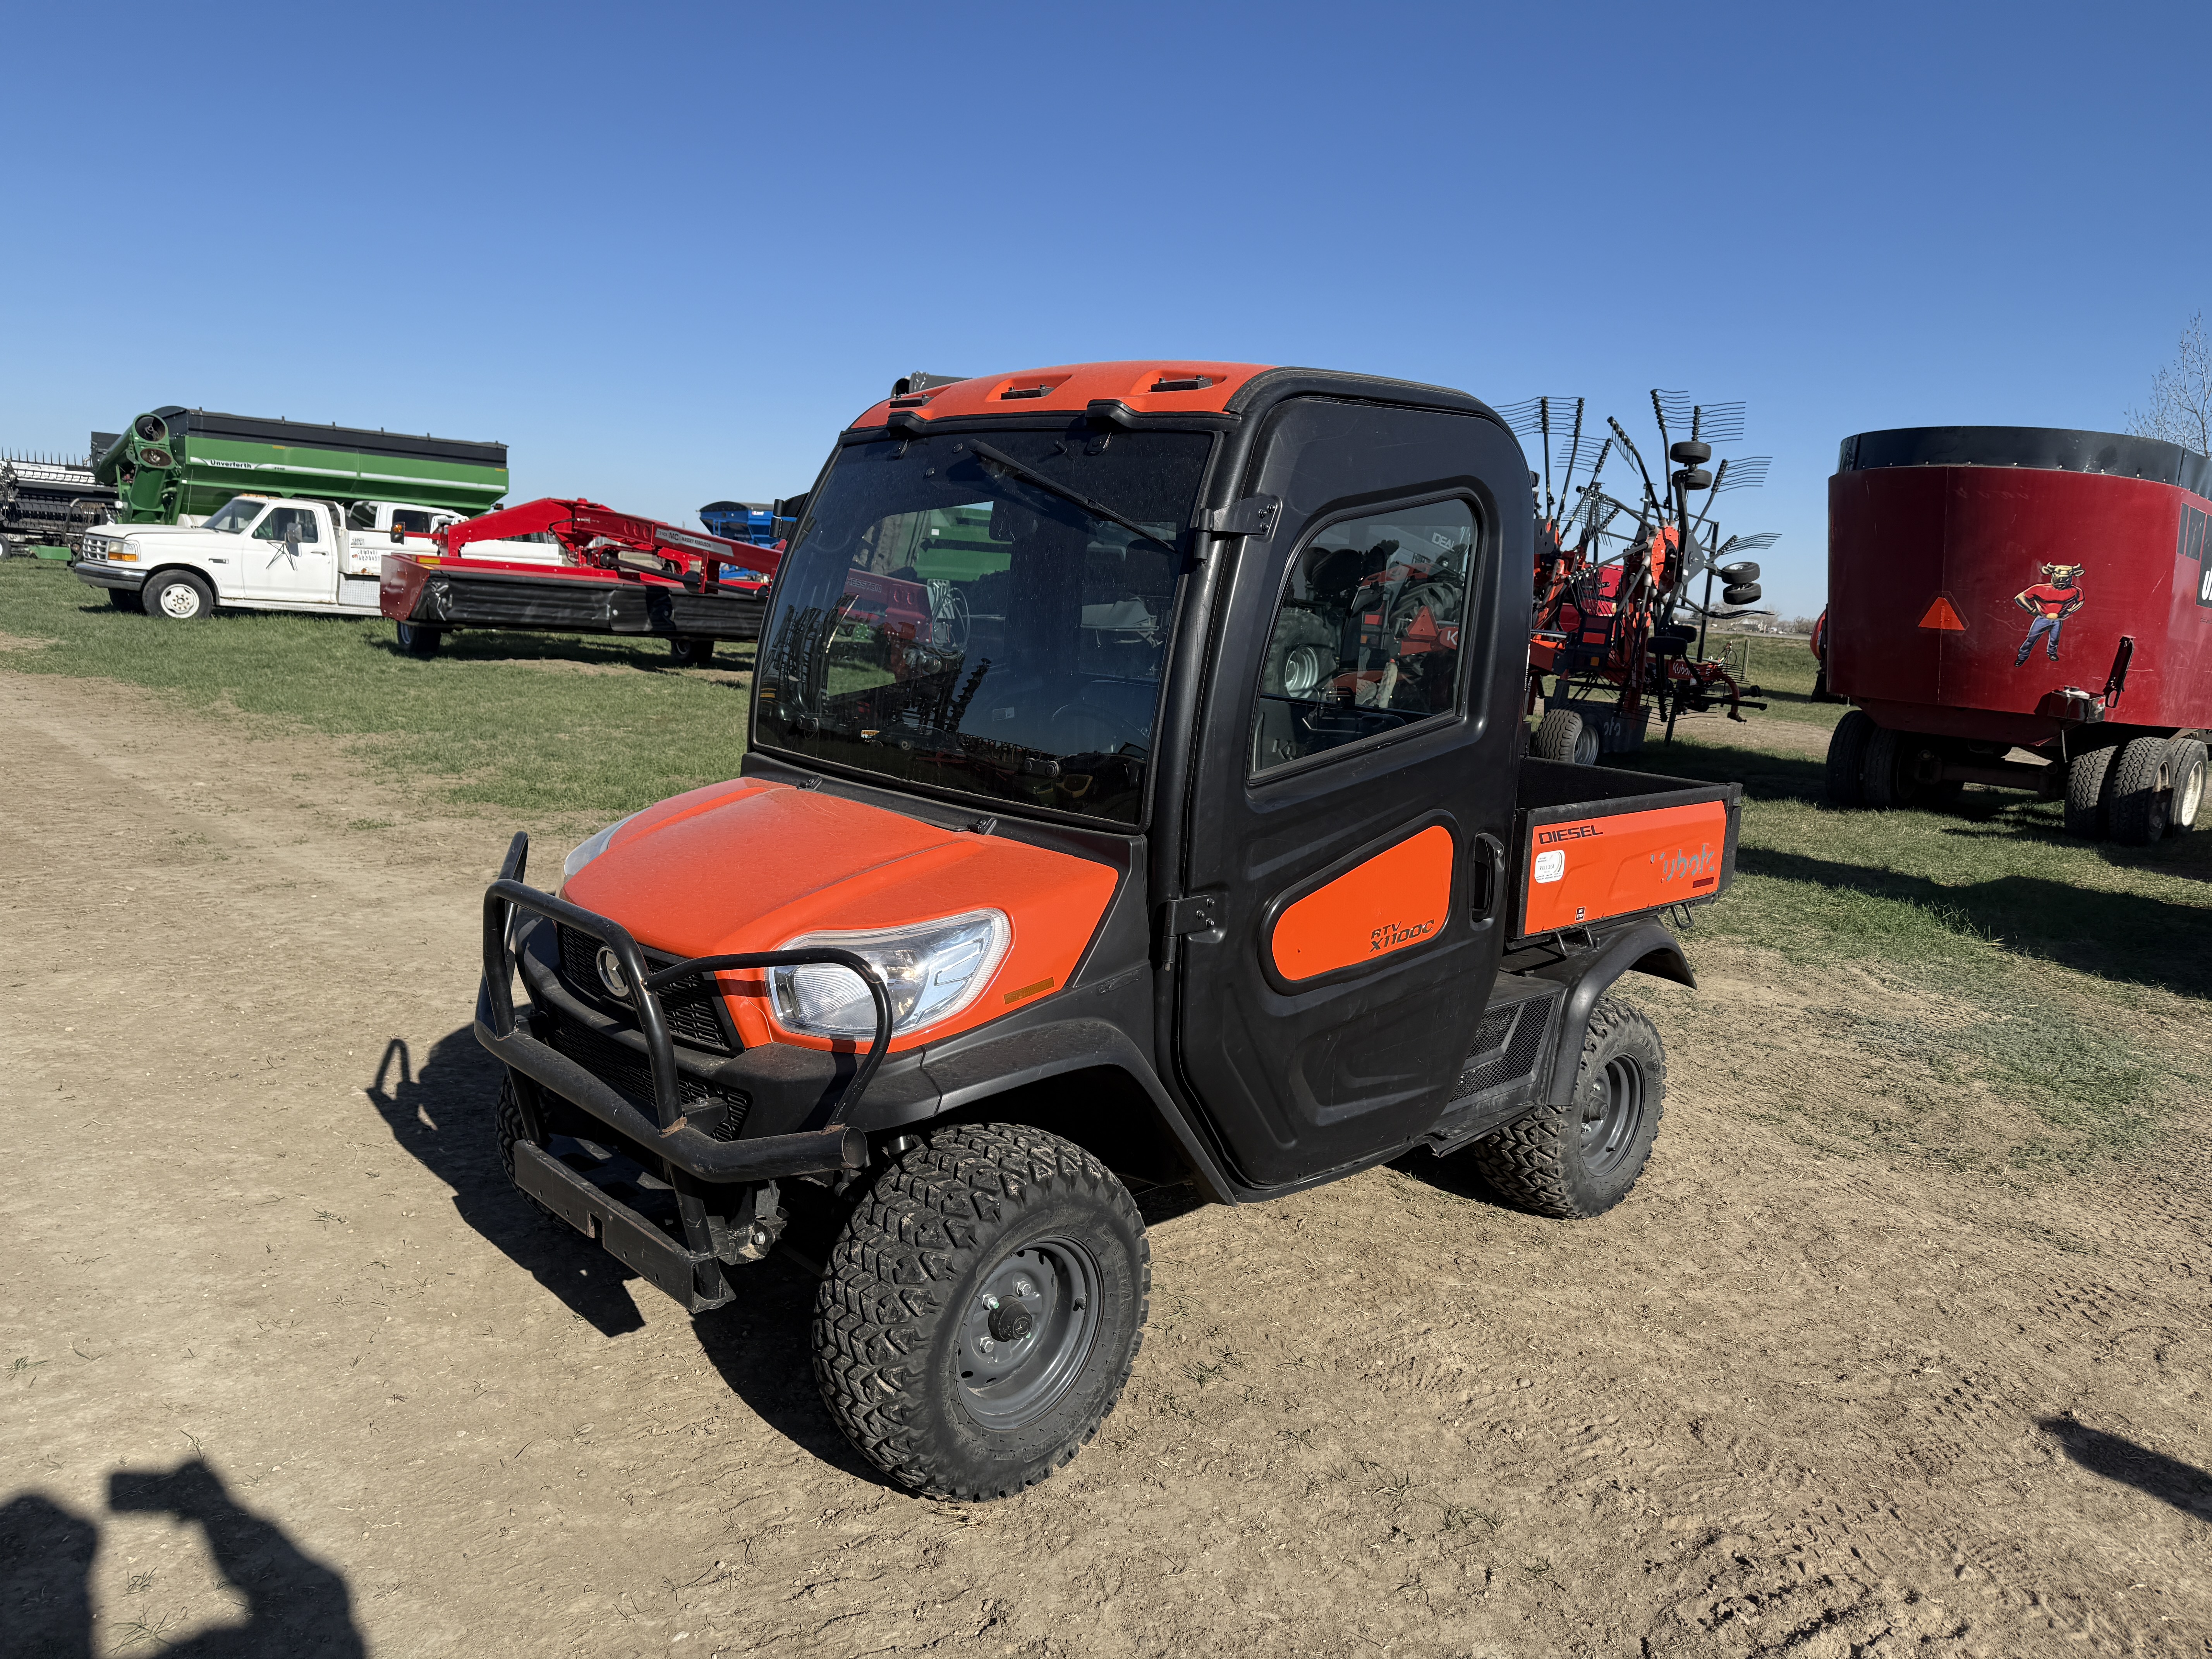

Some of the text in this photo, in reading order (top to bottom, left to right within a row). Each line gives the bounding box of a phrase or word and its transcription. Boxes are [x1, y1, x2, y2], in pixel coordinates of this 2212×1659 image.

[669, 532, 678, 541] MC
[1539, 825, 1604, 844] DIESEL
[1368, 919, 1434, 954] X1100C
[1371, 921, 1401, 939] RTV
